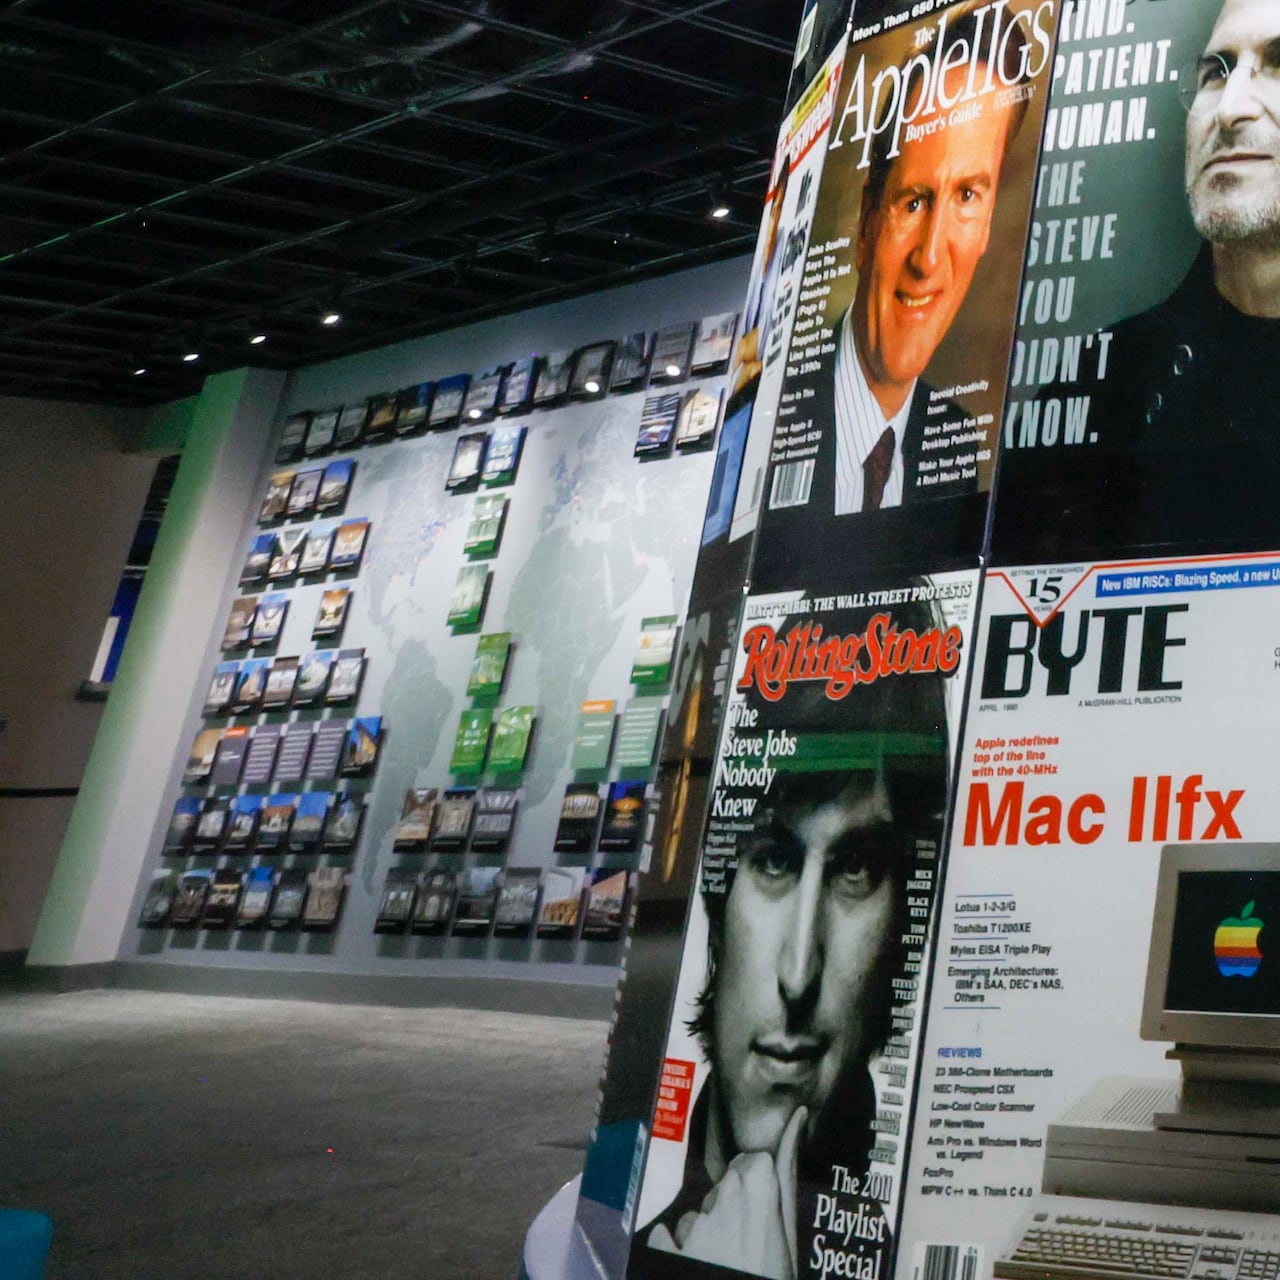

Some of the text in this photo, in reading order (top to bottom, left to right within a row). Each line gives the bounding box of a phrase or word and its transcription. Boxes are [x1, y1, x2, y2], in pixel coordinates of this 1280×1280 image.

[853, 25, 881, 43] More
[883, 11, 909, 28] Than
[911, 2, 933, 17] 650
[914, 26, 936, 48] The
[1051, 41, 1179, 97] PATIENT.
[905, 104, 983, 142] Buyer's Guide
[1043, 97, 1156, 152] HUMAN.
[1037, 161, 1083, 208] THE
[1028, 214, 1119, 266] STEVE
[1018, 278, 1076, 325] YOU
[736, 612, 963, 701] Rolling Stone
[980, 603, 1189, 700] BYTE
[729, 701, 758, 729] The
[722, 729, 797, 759] Steve Jobs
[716, 762, 777, 794] Nobody
[712, 790, 756, 818] Knew
[963, 781, 1106, 847] Mac
[831, 1165, 892, 1203] The 2011
[813, 1194, 886, 1247] Playlist
[810, 1235, 882, 1280] Special
